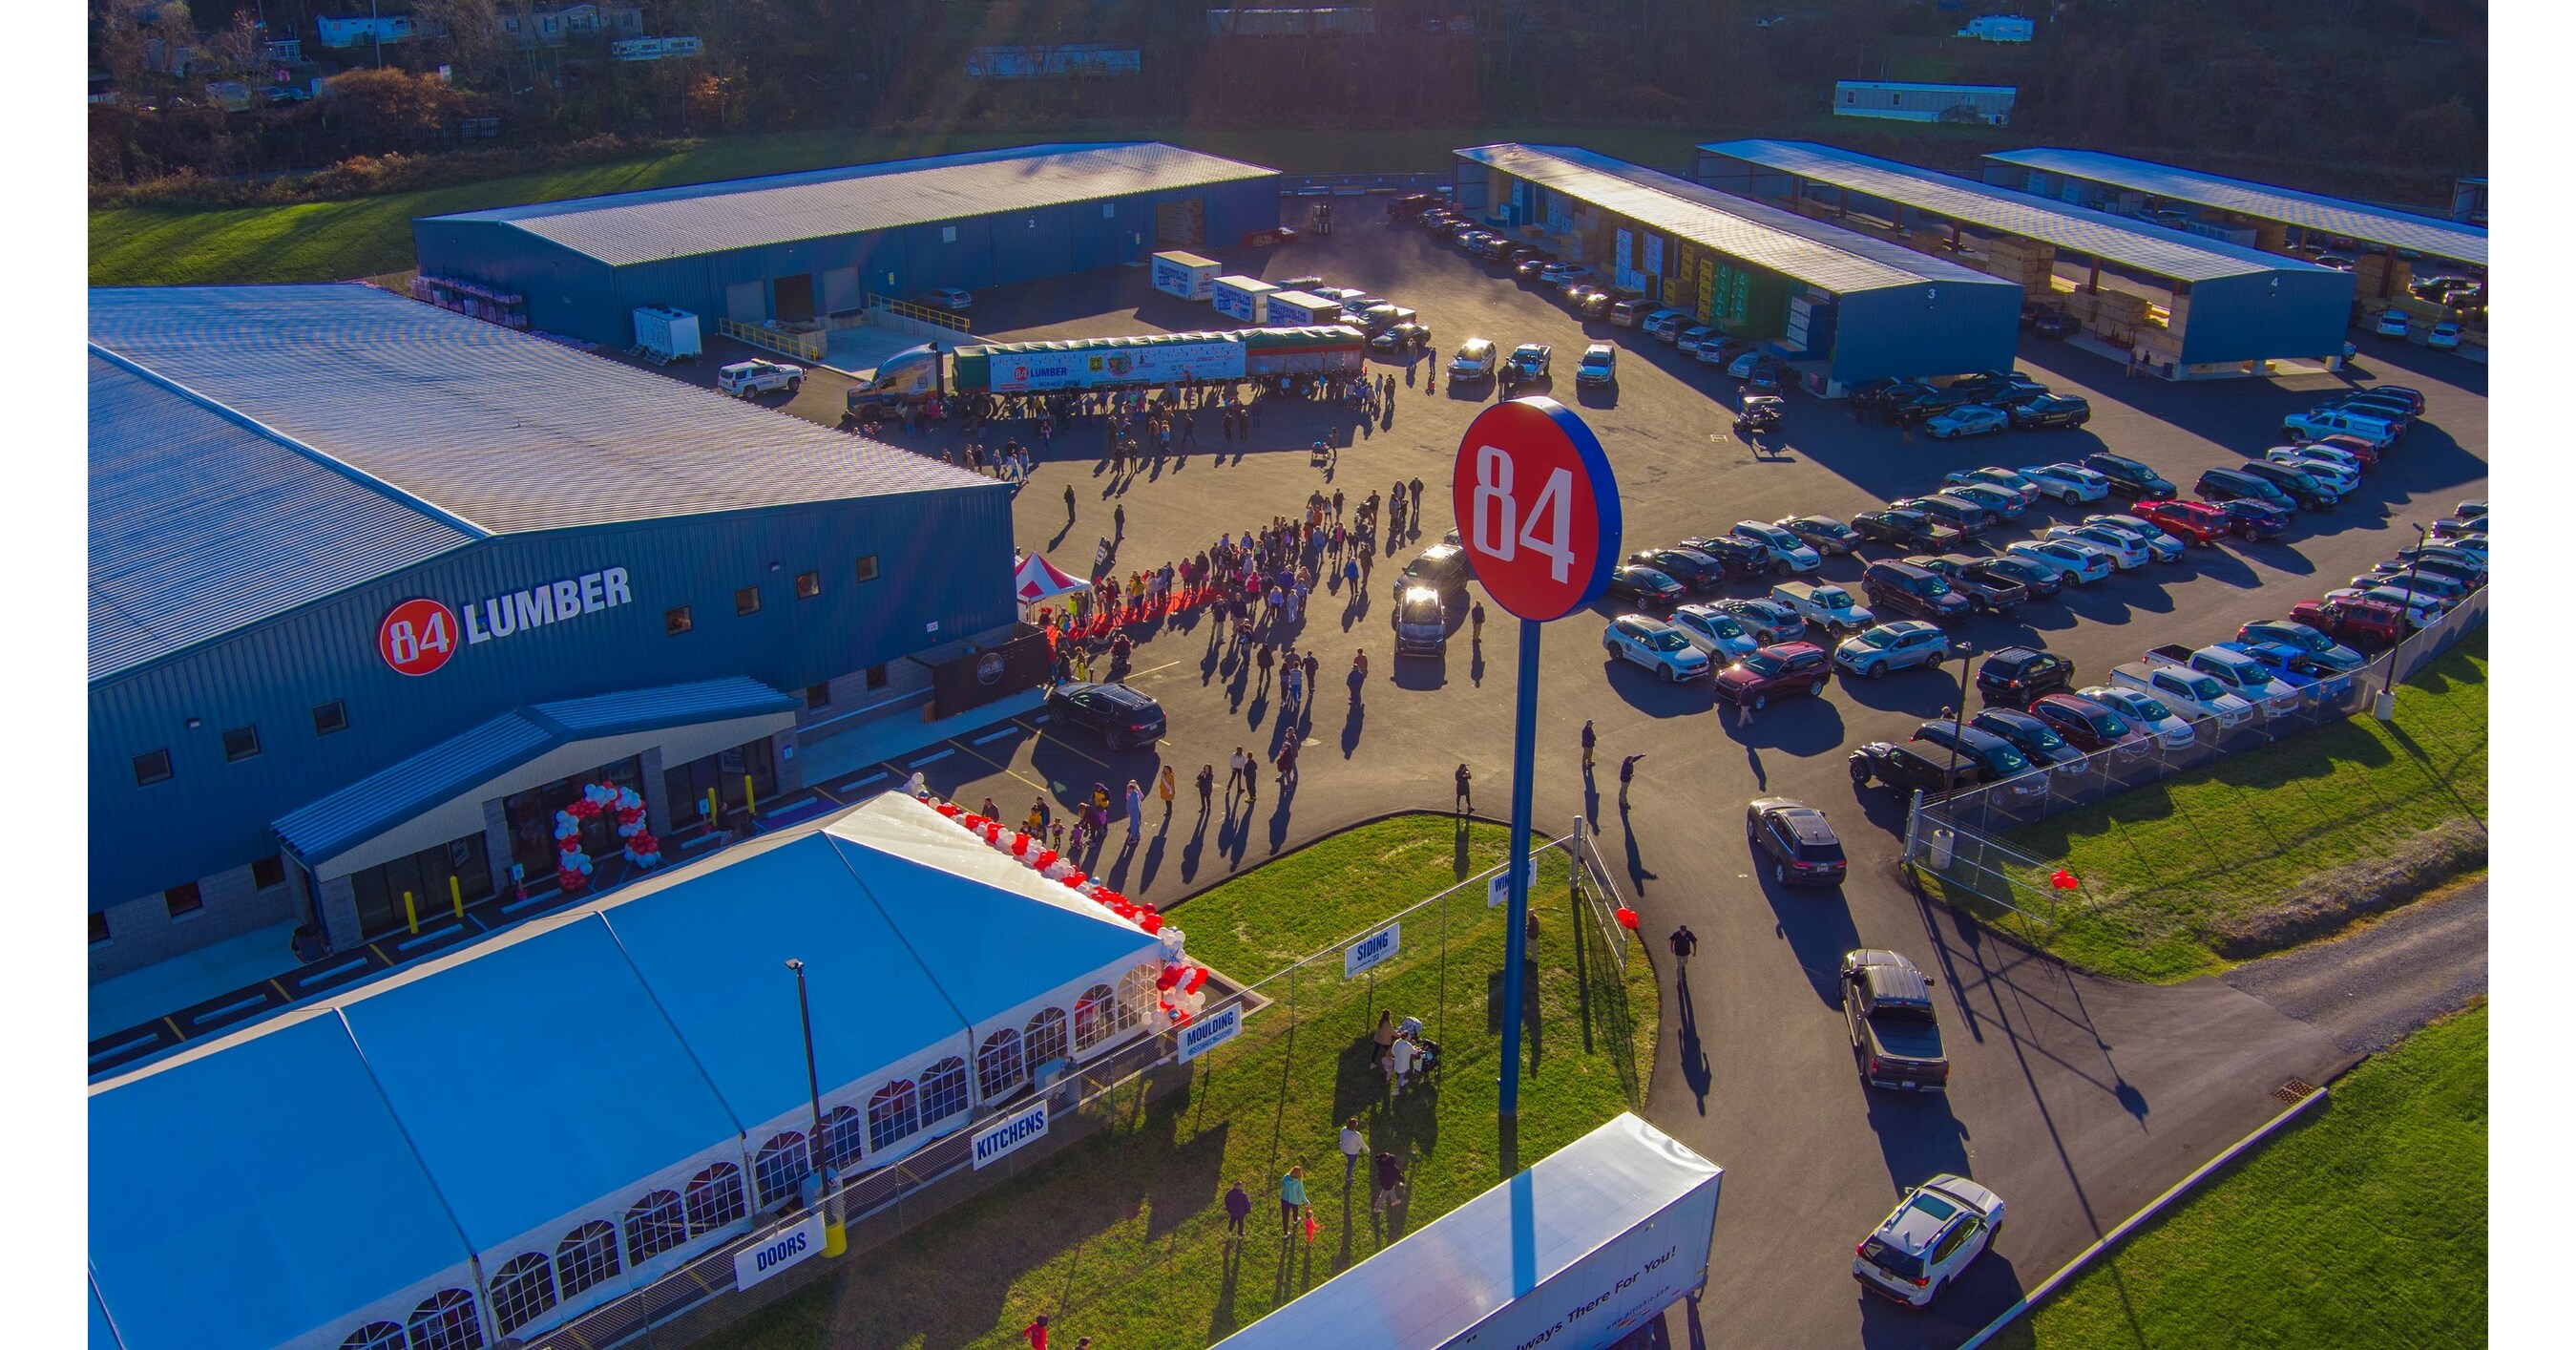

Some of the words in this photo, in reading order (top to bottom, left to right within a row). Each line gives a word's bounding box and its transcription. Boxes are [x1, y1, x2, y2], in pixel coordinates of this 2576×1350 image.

[1029, 219, 1035, 228] 2
[1928, 288, 1936, 299] 3
[2272, 277, 2278, 286] 4
[1015, 368, 1028, 379] 84
[1031, 367, 1067, 377] LUMBER
[1473, 445, 1575, 584] 84
[389, 611, 450, 664] 84
[463, 566, 633, 644] LUMBER
[1357, 932, 1389, 961] SIDING
[1186, 1011, 1234, 1046] MOULDING
[976, 1109, 1044, 1161] KITCHENS
[756, 1232, 806, 1273] DOORS
[1568, 1291, 1611, 1323] There
[1615, 1272, 1640, 1295] For
[1644, 1245, 1677, 1275] You!
